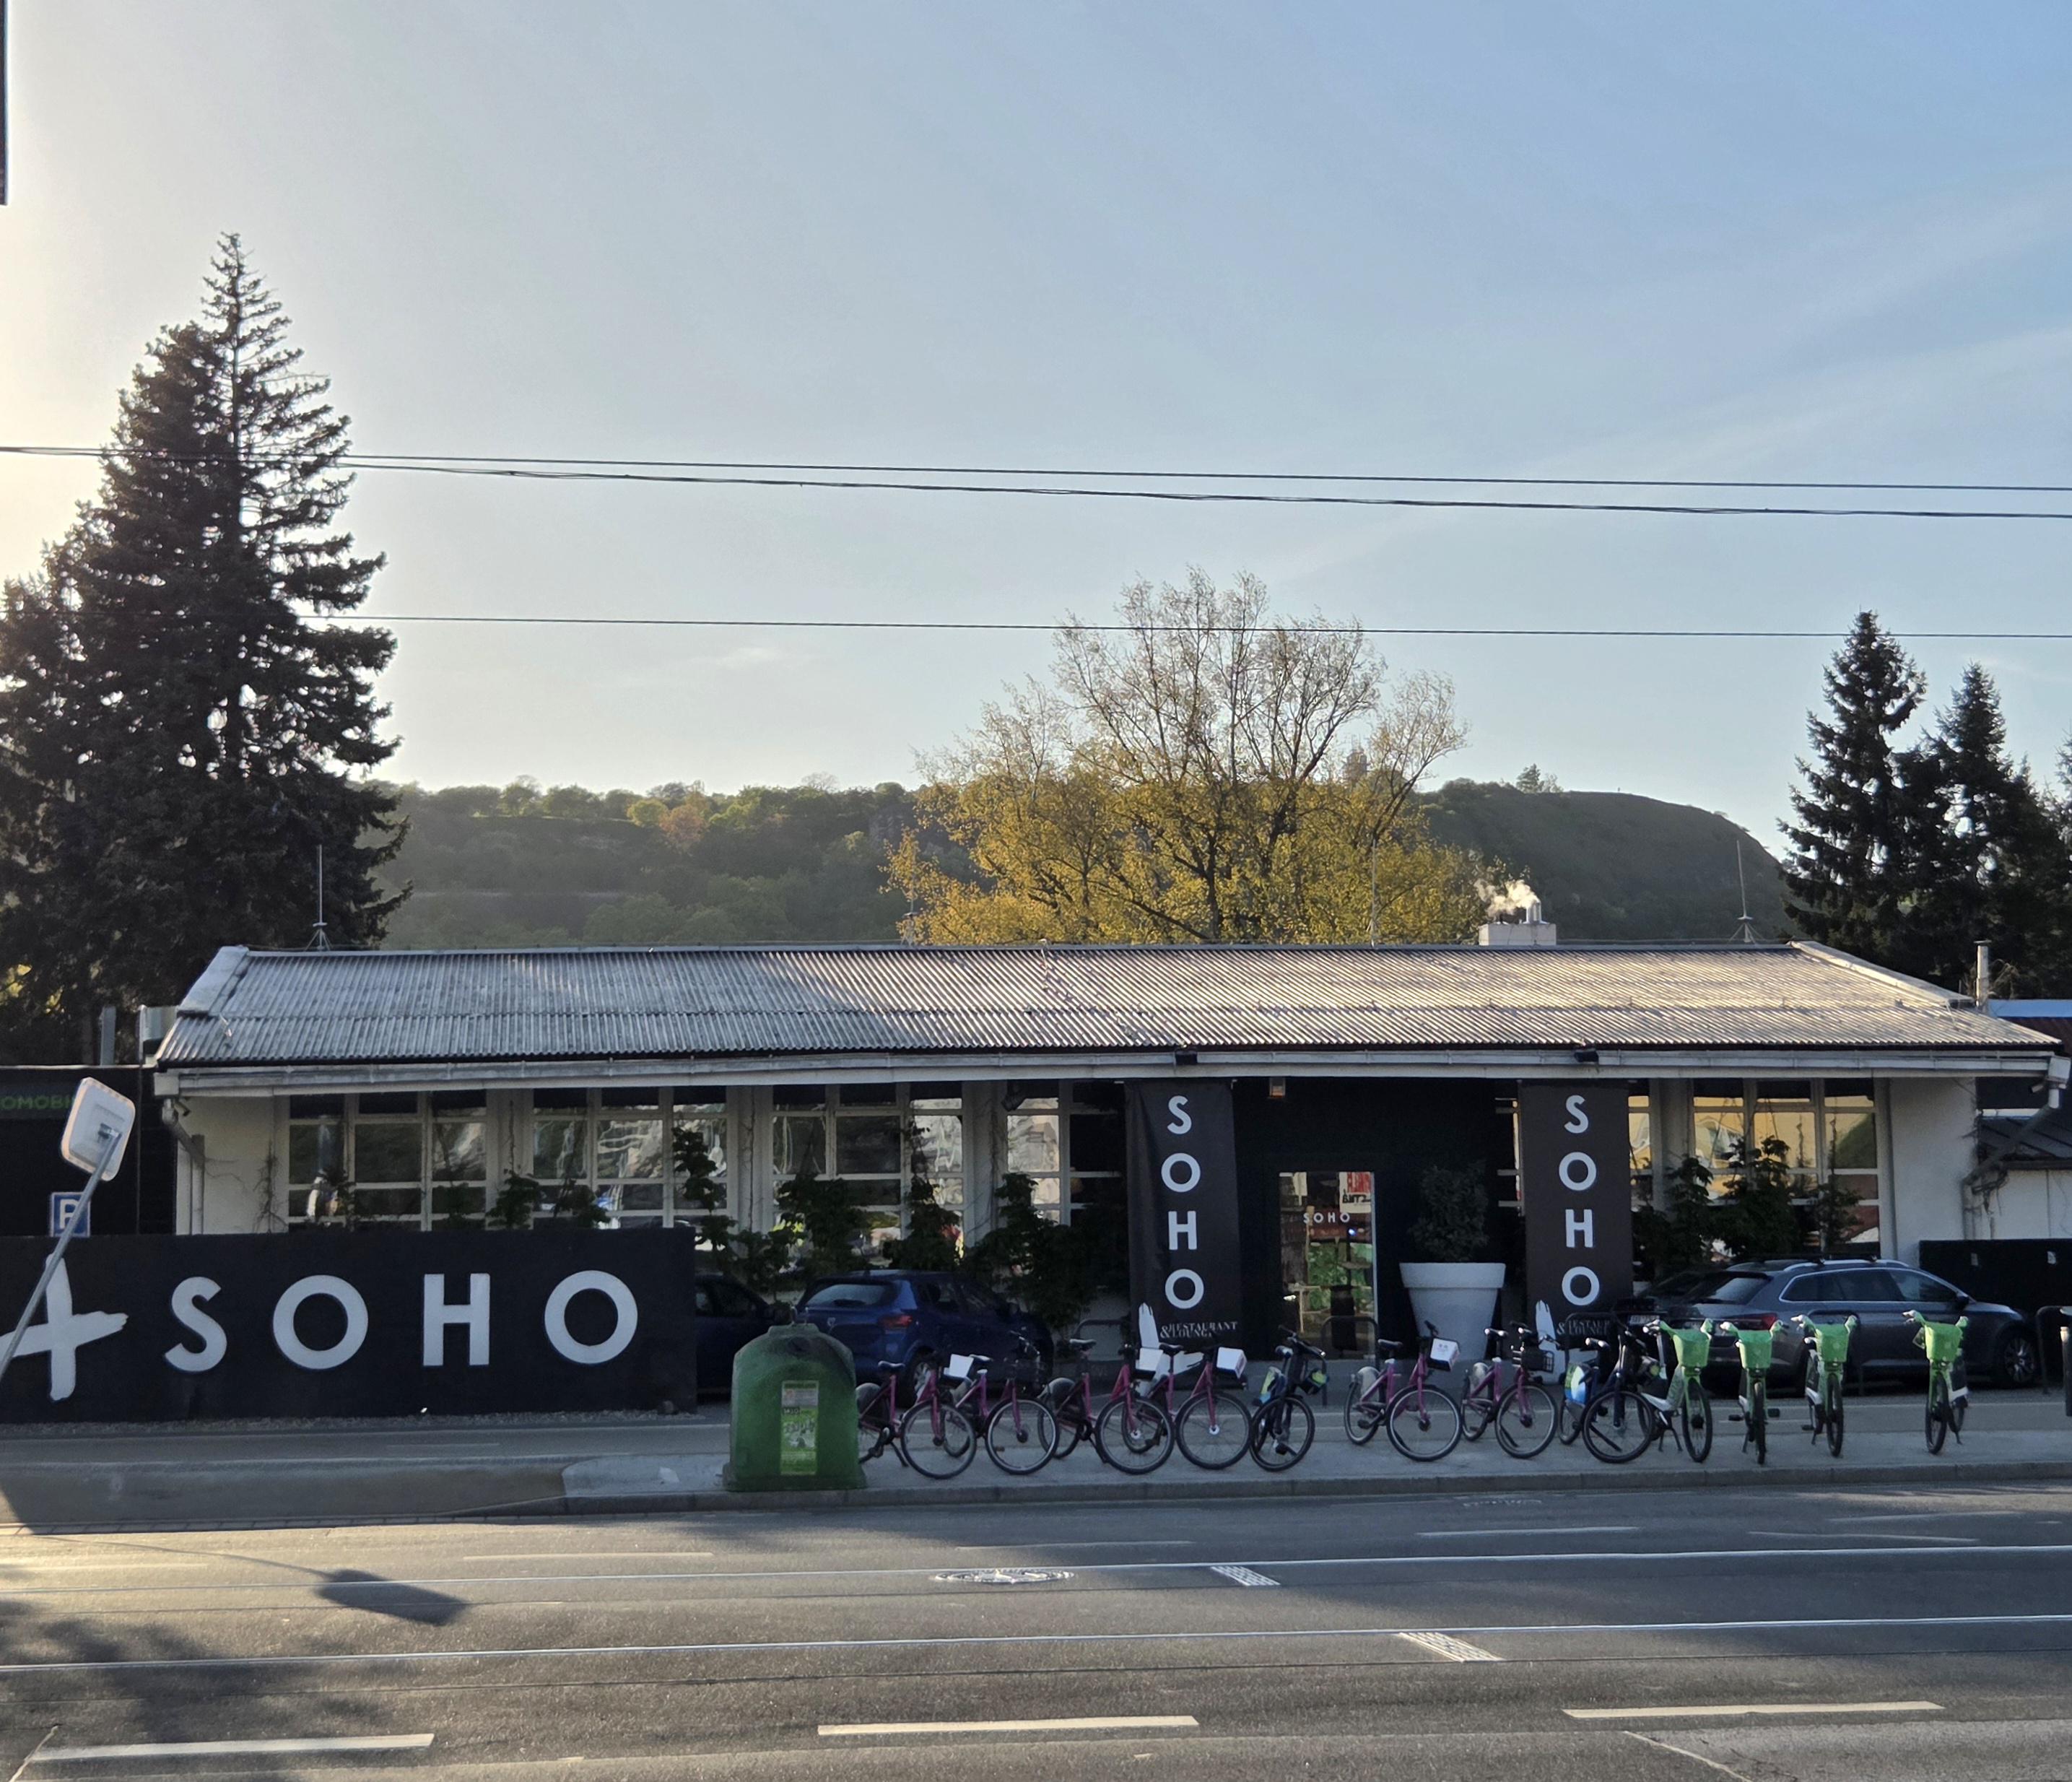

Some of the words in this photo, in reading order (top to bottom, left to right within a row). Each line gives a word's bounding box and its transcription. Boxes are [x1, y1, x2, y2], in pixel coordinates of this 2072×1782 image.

[60, 1199, 80, 1229] P
[1160, 1095, 1205, 1310] SOHO
[1303, 1212, 1350, 1224] SOHO
[1558, 1095, 1601, 1306] SOHO
[164, 1269, 639, 1372] SOHO
[1159, 1325, 1170, 1339] &
